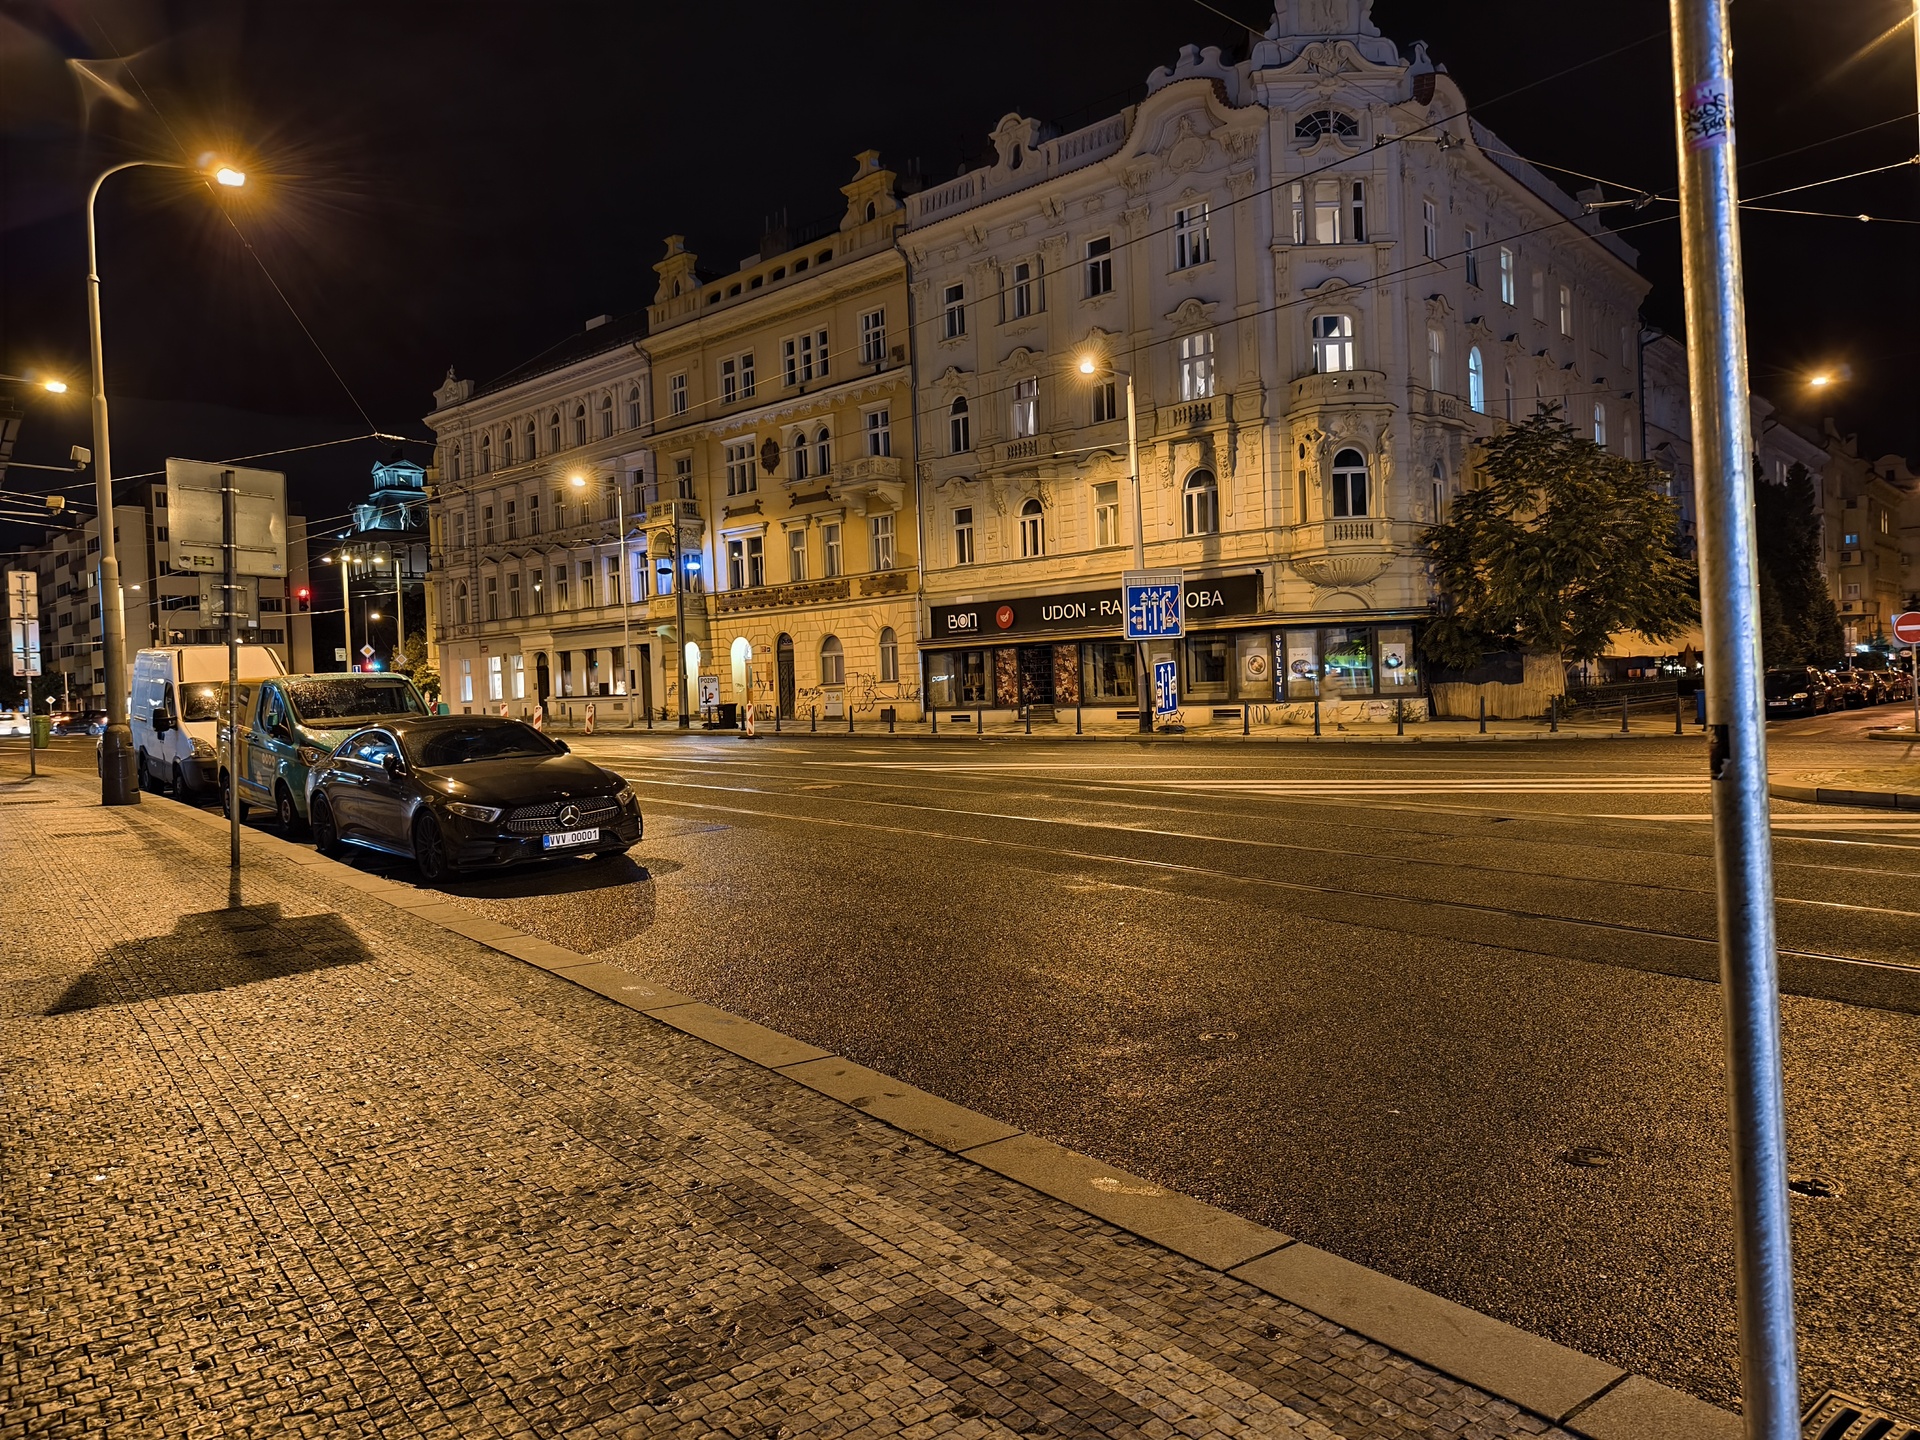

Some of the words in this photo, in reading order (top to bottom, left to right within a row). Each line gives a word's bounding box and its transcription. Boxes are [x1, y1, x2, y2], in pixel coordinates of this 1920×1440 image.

[1042, 602, 1086, 621] UDON
[1100, 599, 1123, 616] RA
[1185, 590, 1225, 609] OBA
[550, 834, 567, 846] VVV
[571, 829, 597, 843] 00001
